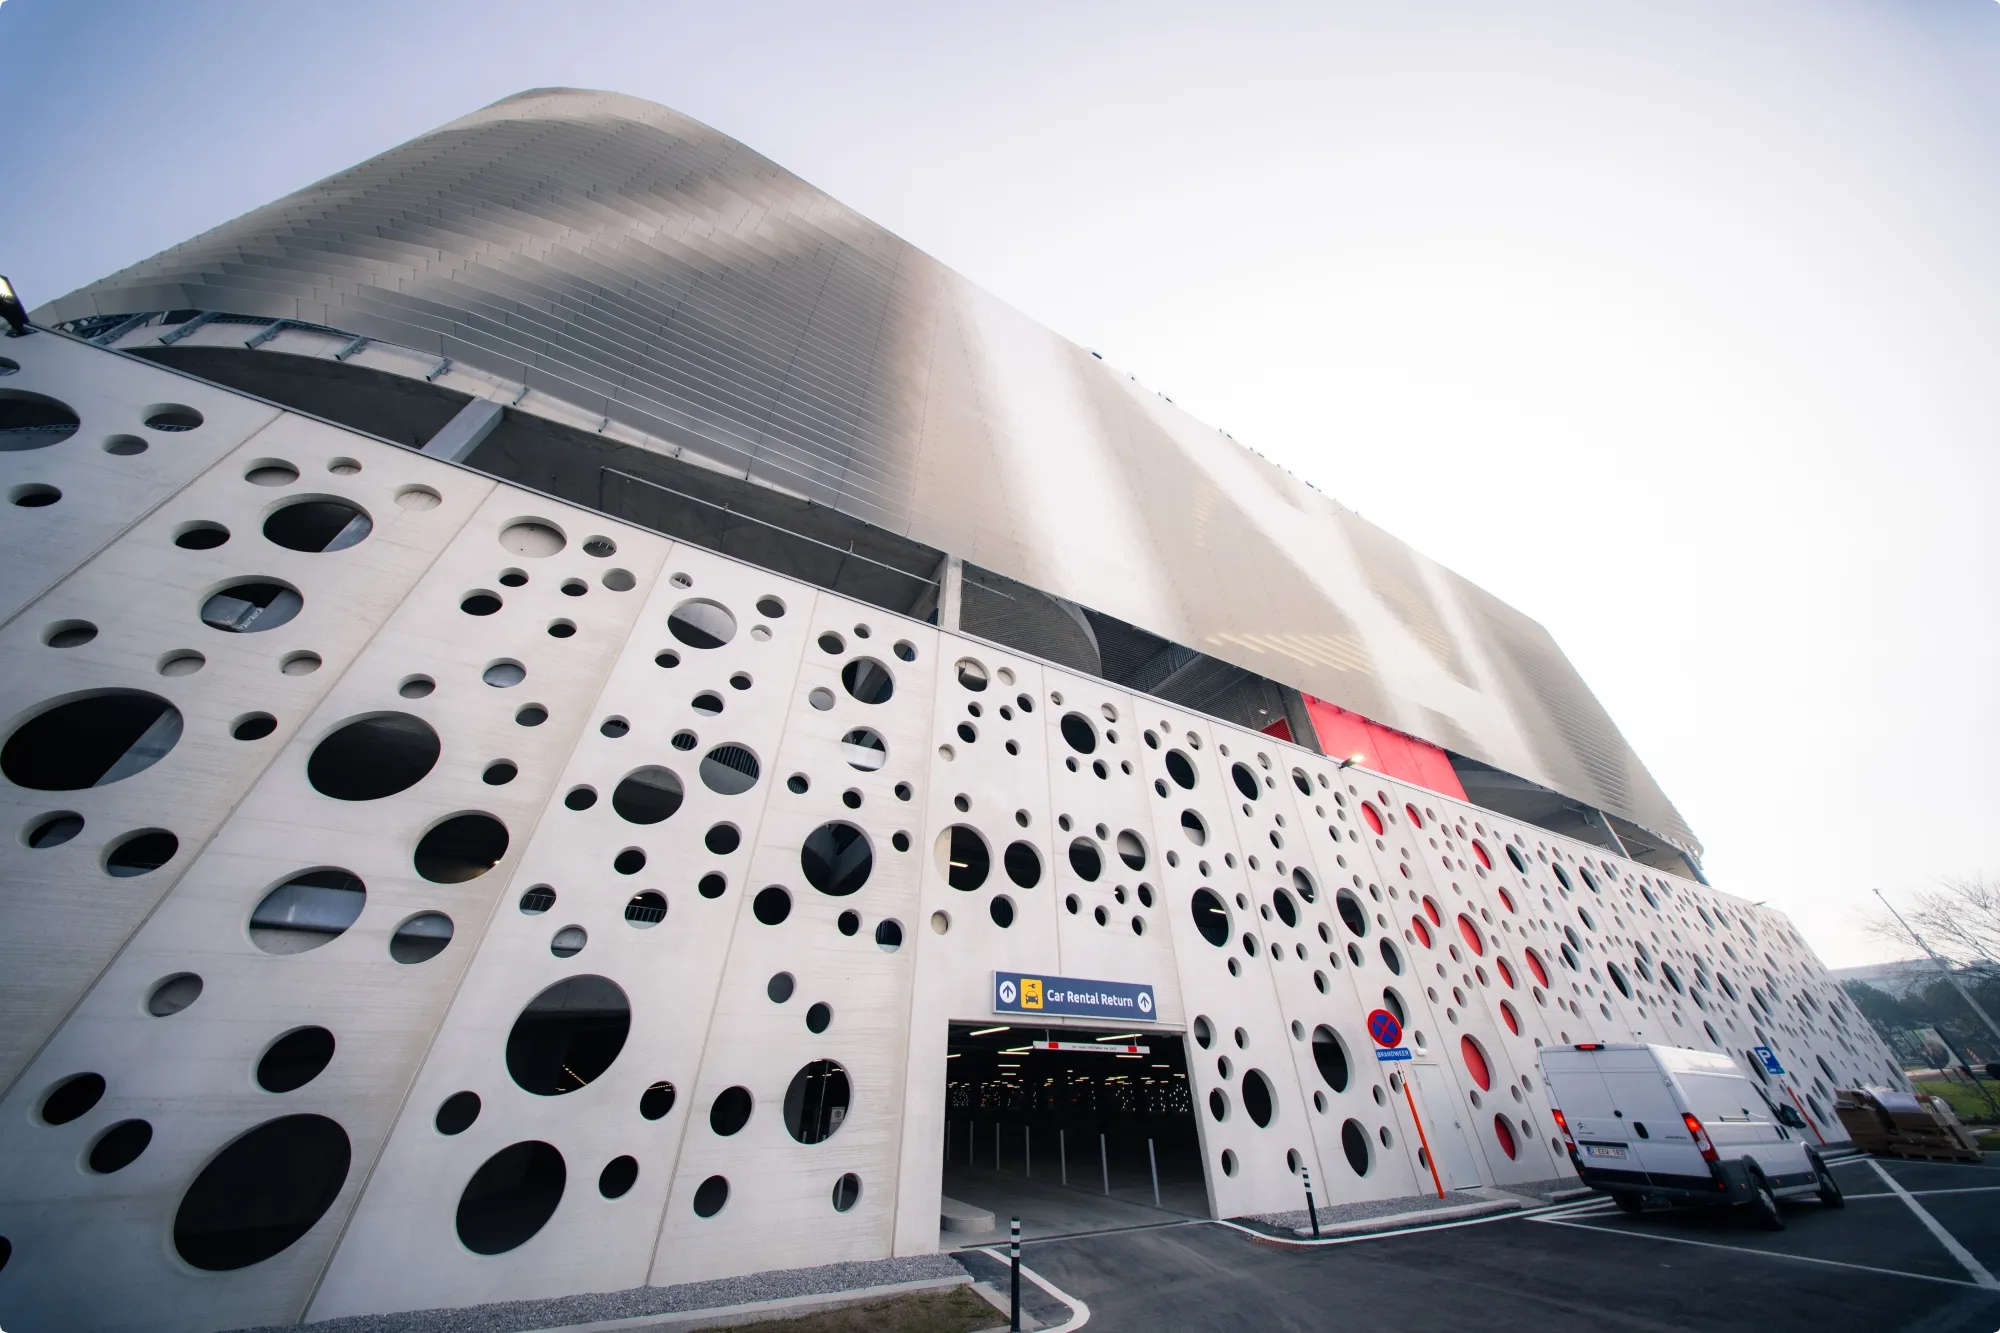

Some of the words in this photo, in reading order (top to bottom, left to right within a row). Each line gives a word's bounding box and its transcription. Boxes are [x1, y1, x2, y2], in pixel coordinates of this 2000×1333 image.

[1047, 989, 1065, 1002] Car
[1067, 990, 1100, 1005] Rental
[1101, 993, 1133, 1007] Return
[1377, 1050, 1409, 1058] BRANDWEER
[1757, 1050, 1771, 1064] P
